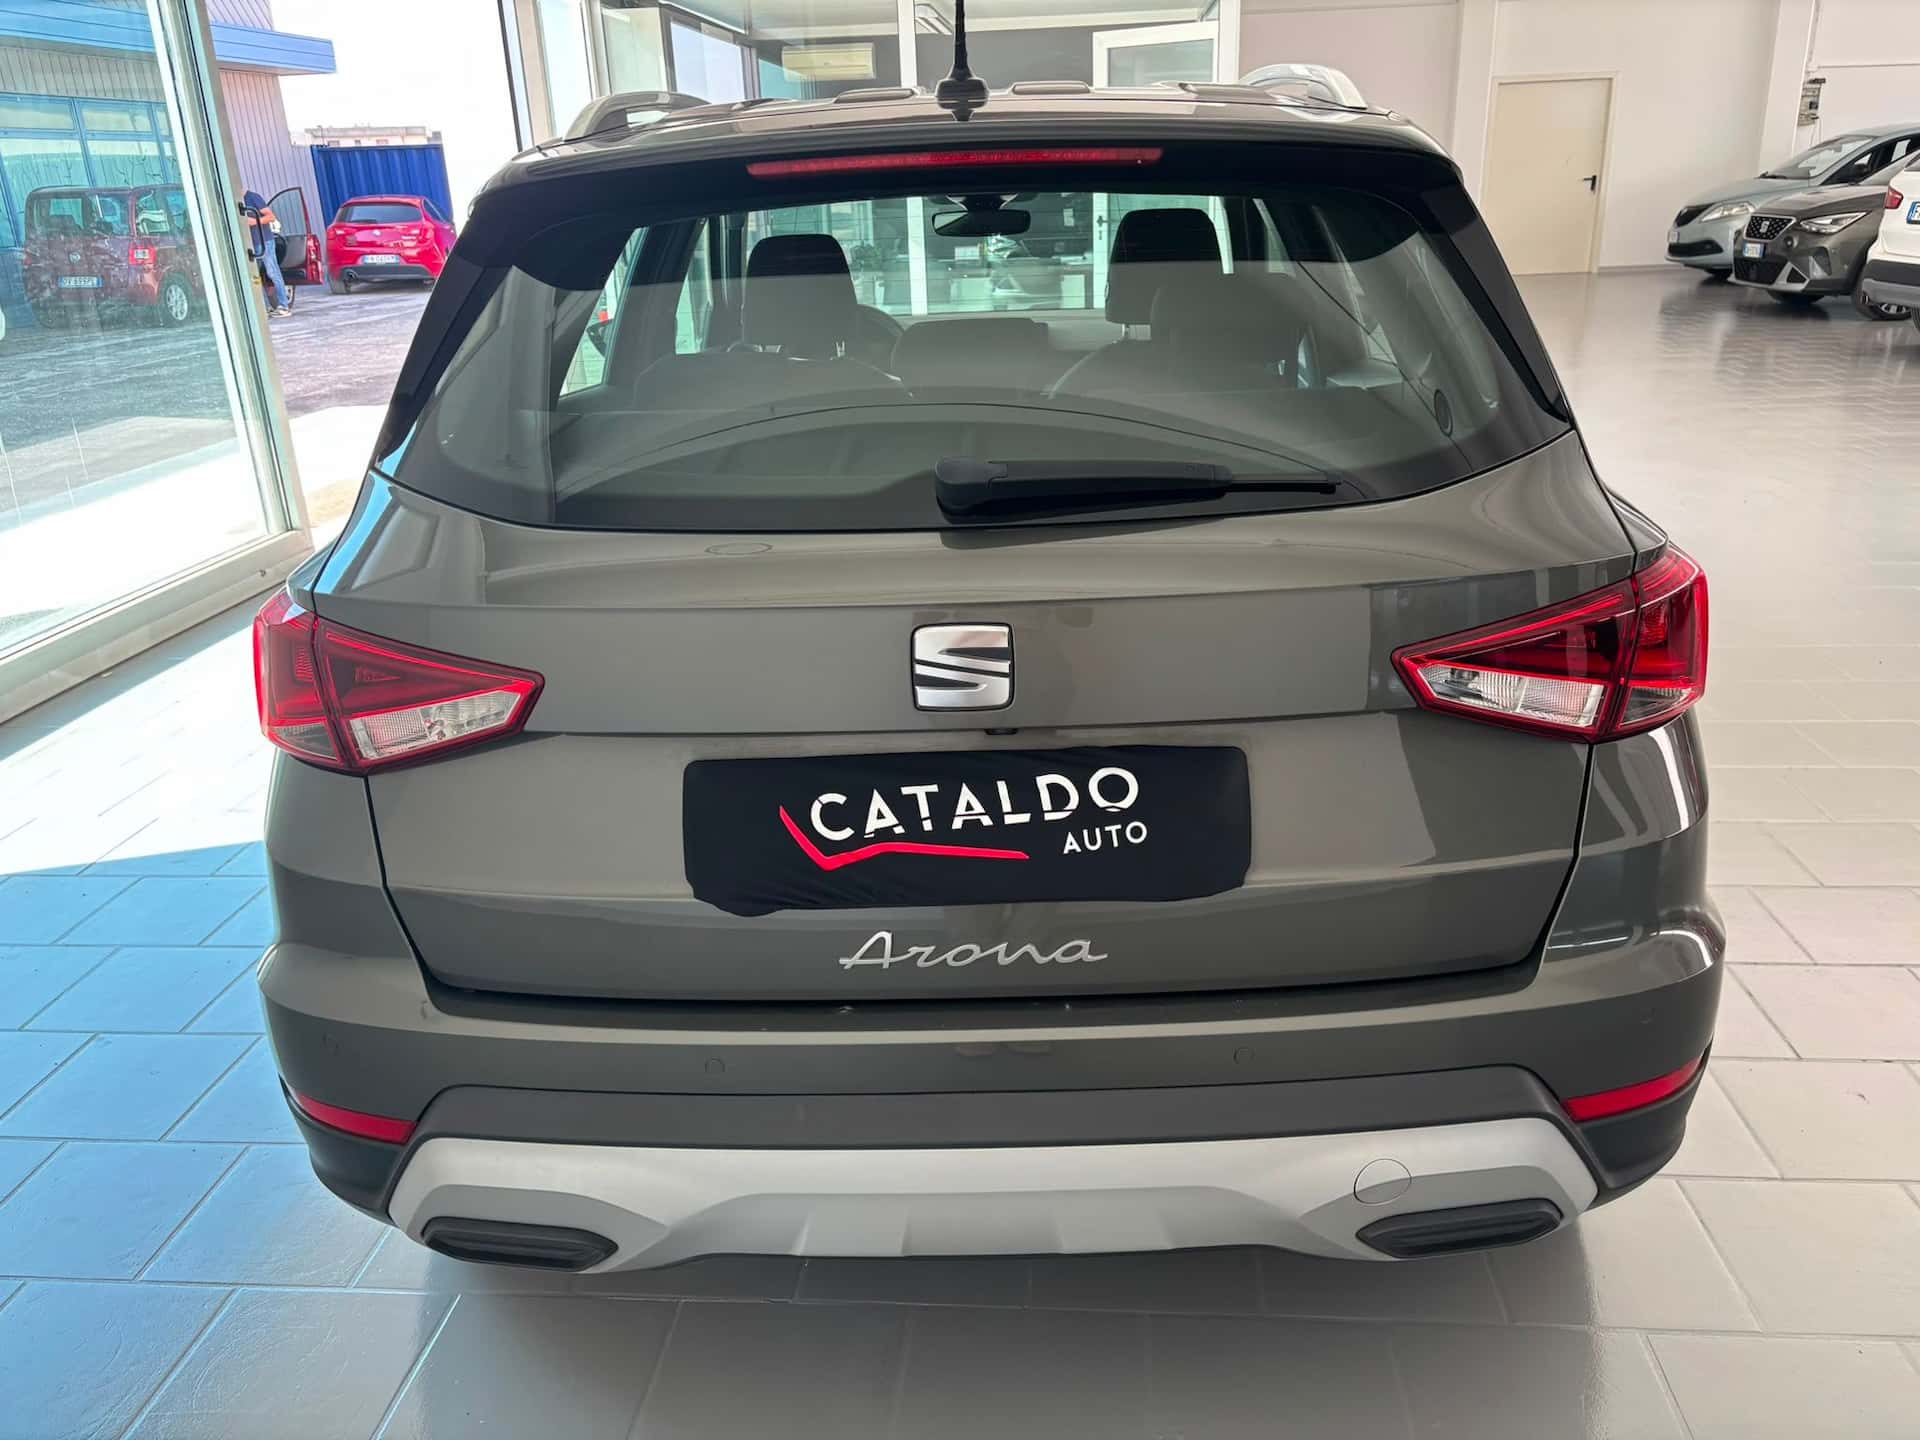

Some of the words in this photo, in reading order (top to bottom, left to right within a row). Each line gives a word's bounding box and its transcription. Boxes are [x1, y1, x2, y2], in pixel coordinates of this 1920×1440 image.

[809, 766, 1140, 841] CATALDO
[1062, 820, 1149, 855] AUTO
[838, 930, 1108, 970] Arona
